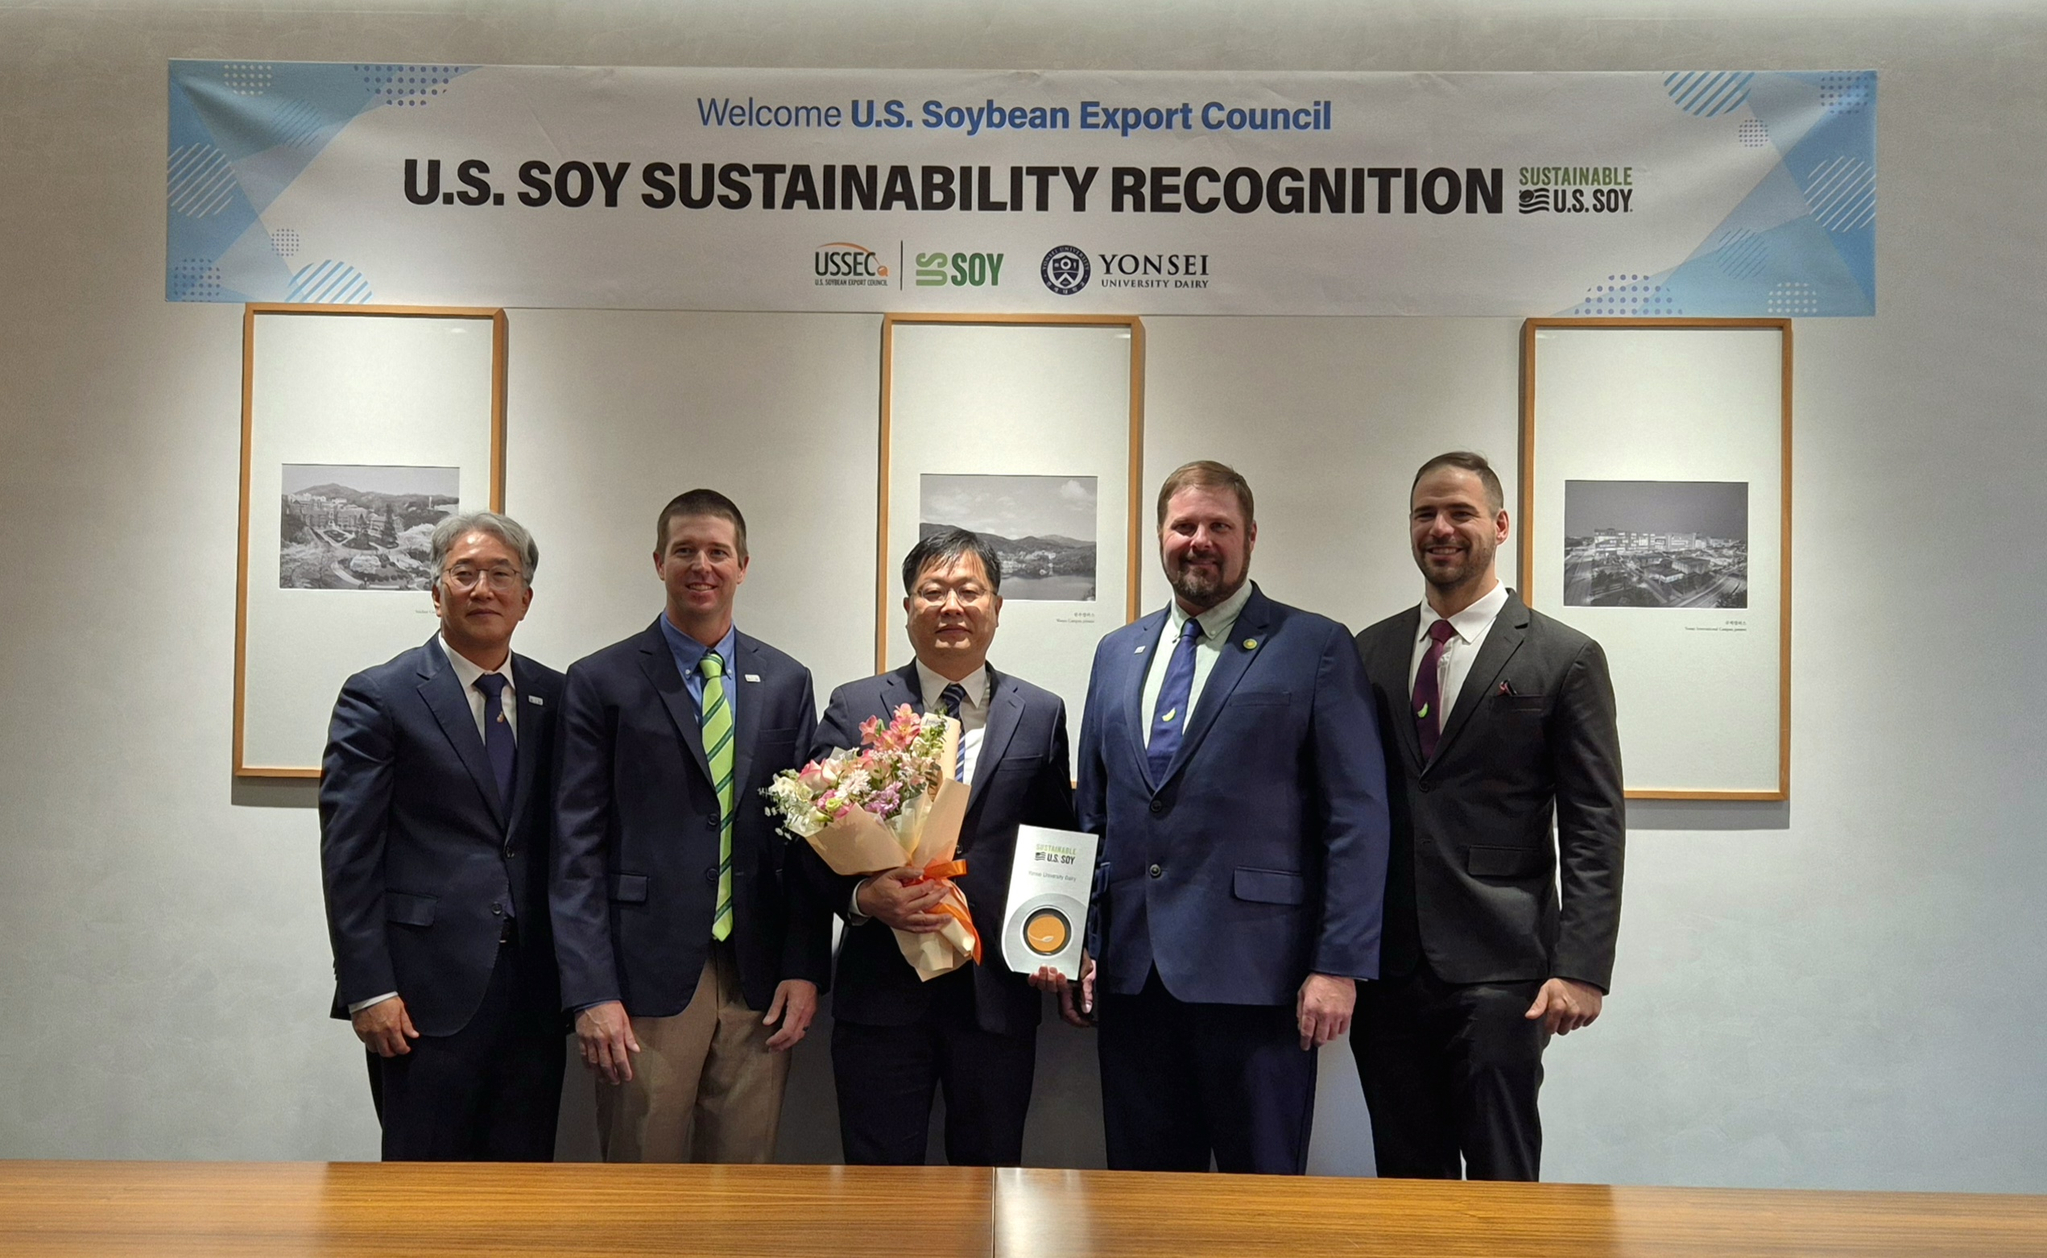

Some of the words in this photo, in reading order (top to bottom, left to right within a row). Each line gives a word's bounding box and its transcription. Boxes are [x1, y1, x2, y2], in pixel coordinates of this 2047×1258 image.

[697, 97, 841, 127] Welcome
[852, 100, 912, 128] U.S.
[922, 99, 1069, 136] Soybean
[1081, 101, 1193, 137] Export
[1202, 101, 1332, 130] Council
[404, 159, 504, 206] U.S.
[517, 161, 631, 208] SOY
[641, 162, 1099, 213] SUSTAINABILITY
[1112, 166, 1503, 214] RECOGNITION
[1519, 166, 1633, 186] SUSTAINABLE
[1553, 188, 1590, 213] U.S.
[815, 251, 876, 276] USSEC
[950, 252, 1004, 287] SOY
[1098, 253, 1209, 276] YONSEI
[825, 279, 847, 287] SOYBEAN
[848, 279, 866, 287] EXPORT
[867, 279, 888, 287] COUNCIL
[1101, 279, 1169, 289] UNIVERSITY
[1174, 280, 1209, 289] DAIRY
[1036, 844, 1077, 855] SUSTAINABLE
[1060, 855, 1076, 864] SOY
